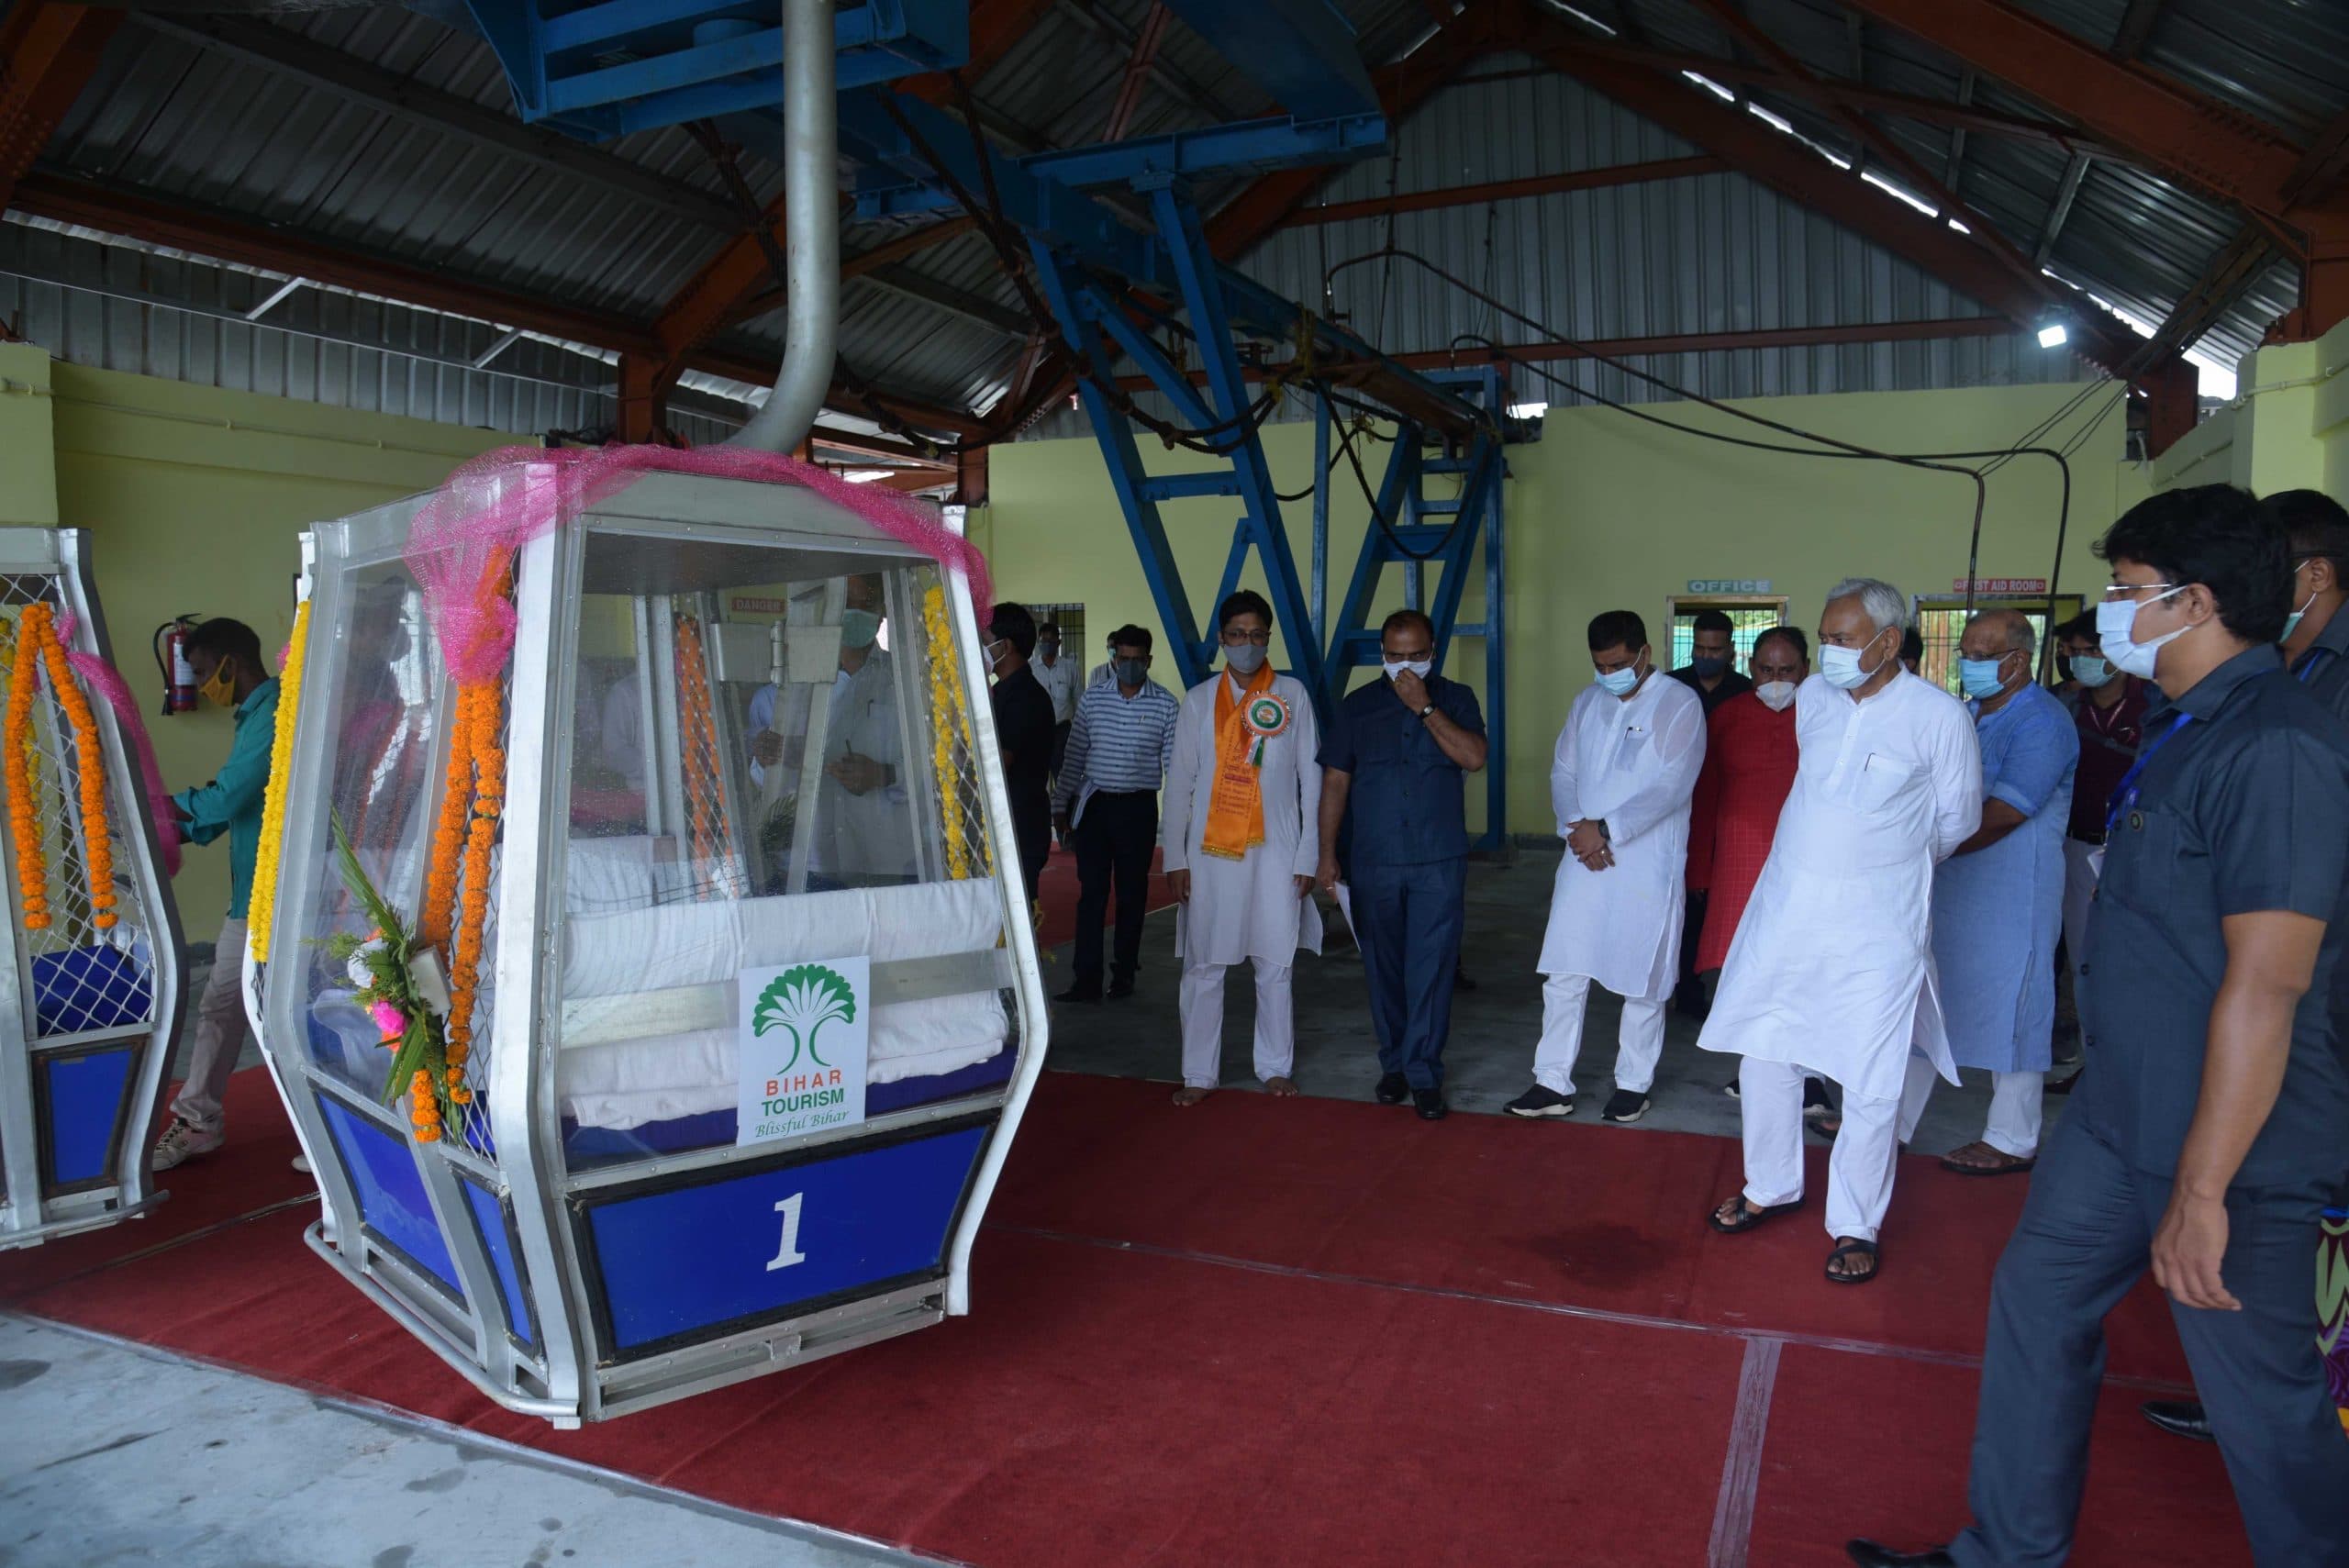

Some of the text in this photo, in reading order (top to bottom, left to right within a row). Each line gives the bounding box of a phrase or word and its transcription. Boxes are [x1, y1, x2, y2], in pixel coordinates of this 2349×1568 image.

[1690, 579, 1771, 593] OFFICE
[1990, 580, 2007, 592] AID
[2009, 579, 2036, 592] ROOM
[765, 1069, 841, 1096] BIHAR
[762, 1087, 844, 1117] TOURISM
[755, 1109, 850, 1138] Blissful Bihar
[766, 1192, 806, 1272] 1
